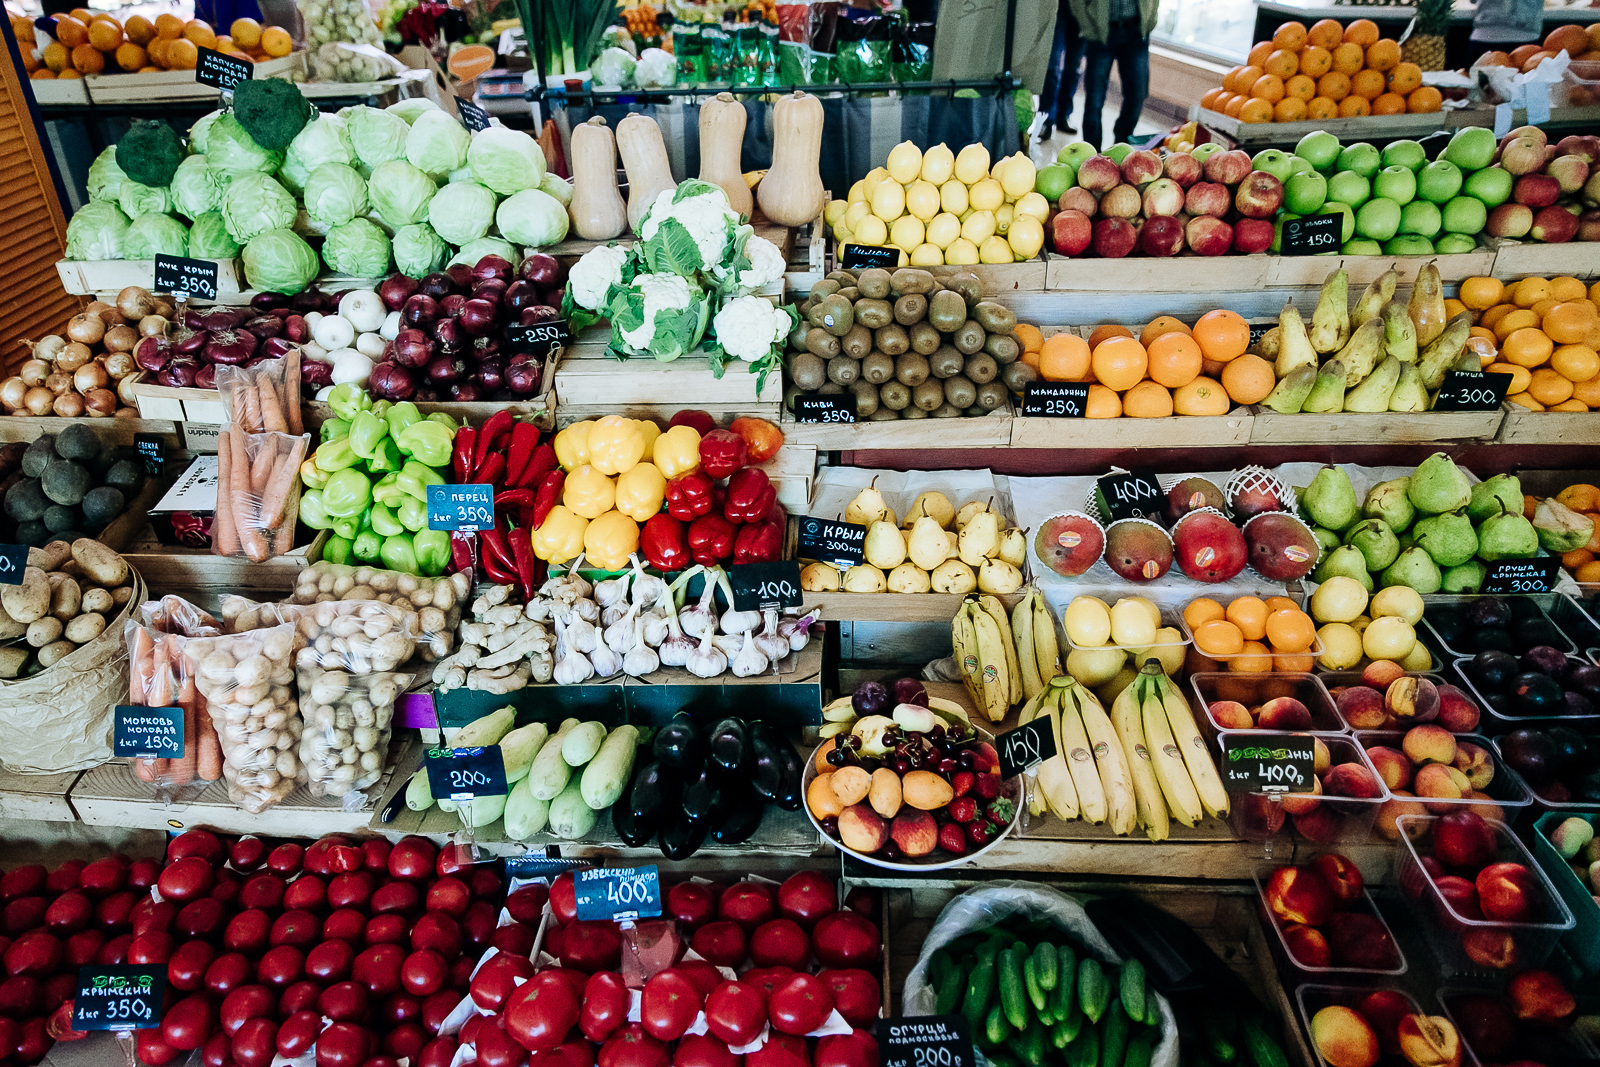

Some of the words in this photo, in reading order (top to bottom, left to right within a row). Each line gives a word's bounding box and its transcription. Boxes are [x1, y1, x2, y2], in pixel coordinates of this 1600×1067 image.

[206, 54, 248, 73] КАПУСТА
[158, 261, 179, 271] ЛУК
[183, 265, 214, 277] КРЫМ
[1455, 371, 1484, 379] ГРУША
[1030, 388, 1087, 397] МАНДАРИНЫ
[1025, 404, 1042, 413] 1кг
[187, 429, 219, 438] ehadrin
[451, 493, 489, 504] ПЕРЕЦ
[433, 512, 451, 522] 1кг
[823, 525, 865, 540] КРЫМ
[1498, 564, 1535, 573] ГРУША
[1491, 569, 1546, 579] КРЫМСКАЯ
[123, 716, 174, 726] МОРКОВЬ
[127, 726, 177, 735] МОЛОДАЯ
[119, 738, 138, 747] 1кг
[1004, 726, 1040, 768] 150
[1228, 769, 1250, 780] 1кг
[77, 1007, 99, 1020] 1кг
[889, 1022, 947, 1037] ОГУРЦЫ
